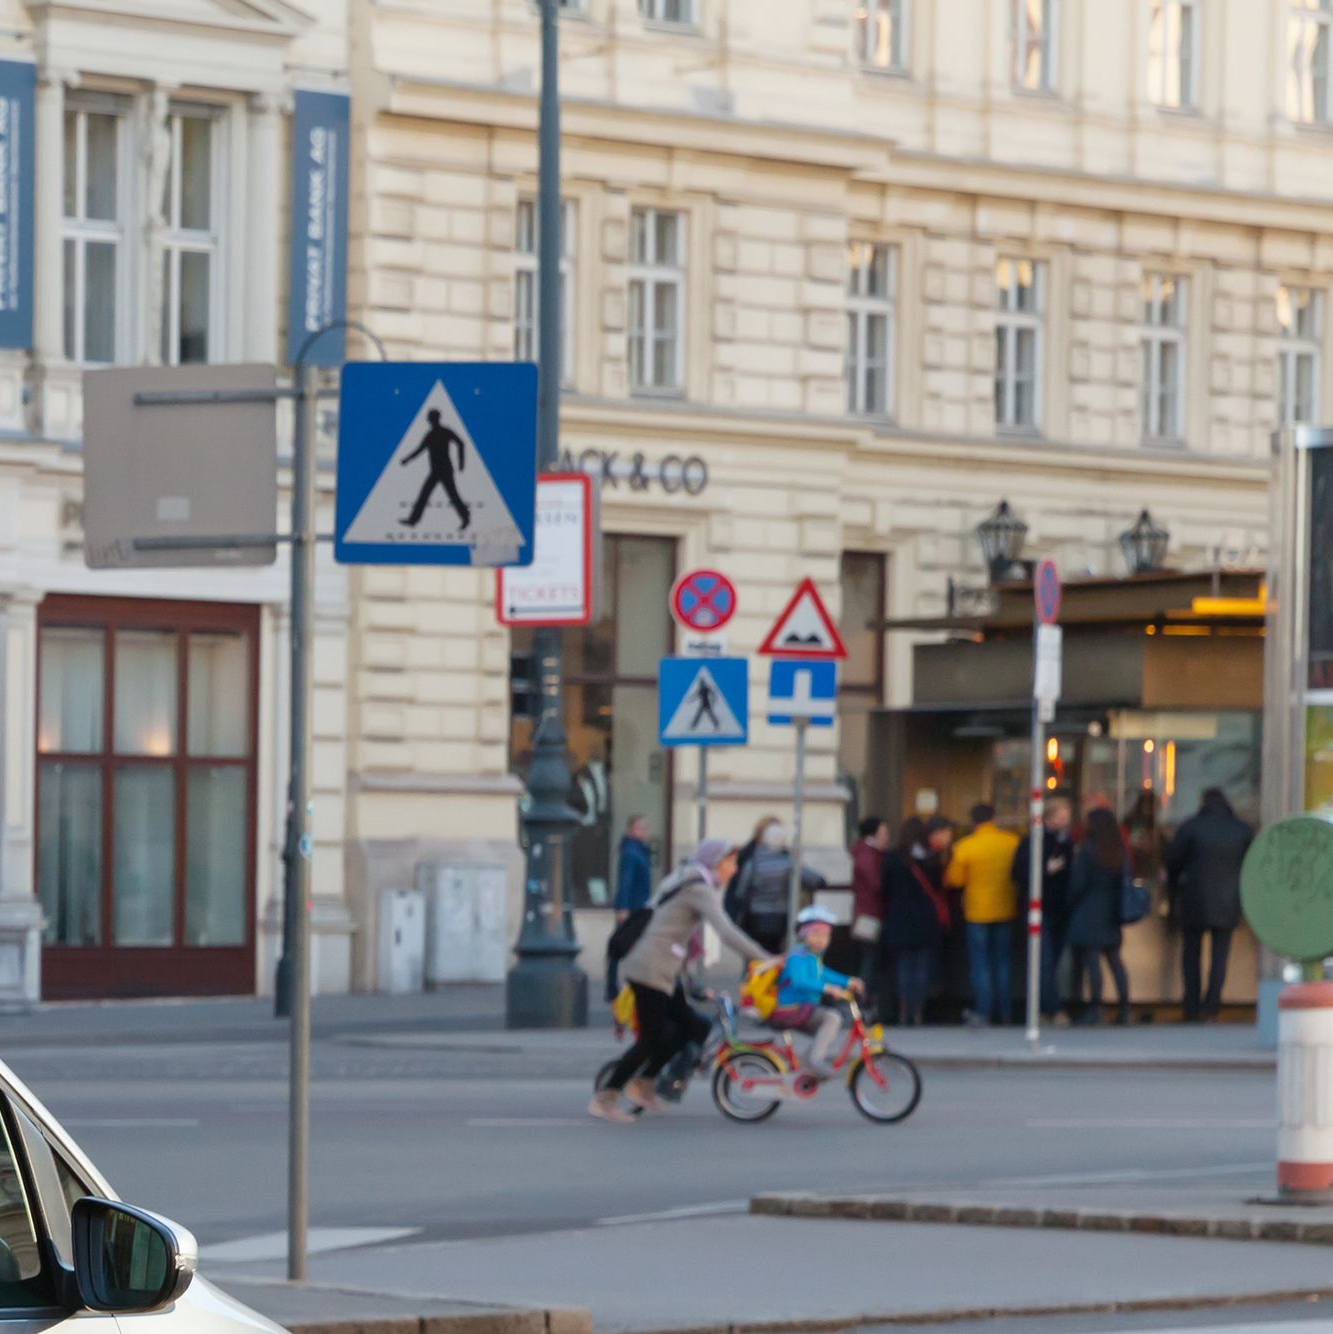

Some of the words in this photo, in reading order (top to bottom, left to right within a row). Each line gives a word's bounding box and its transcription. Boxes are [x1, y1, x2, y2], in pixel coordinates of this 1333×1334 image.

[309, 126, 327, 164] AG
[307, 169, 325, 239] BANK
[305, 243, 323, 332] PRIVAT
[630, 452, 649, 492] &
[659, 454, 709, 495] CO
